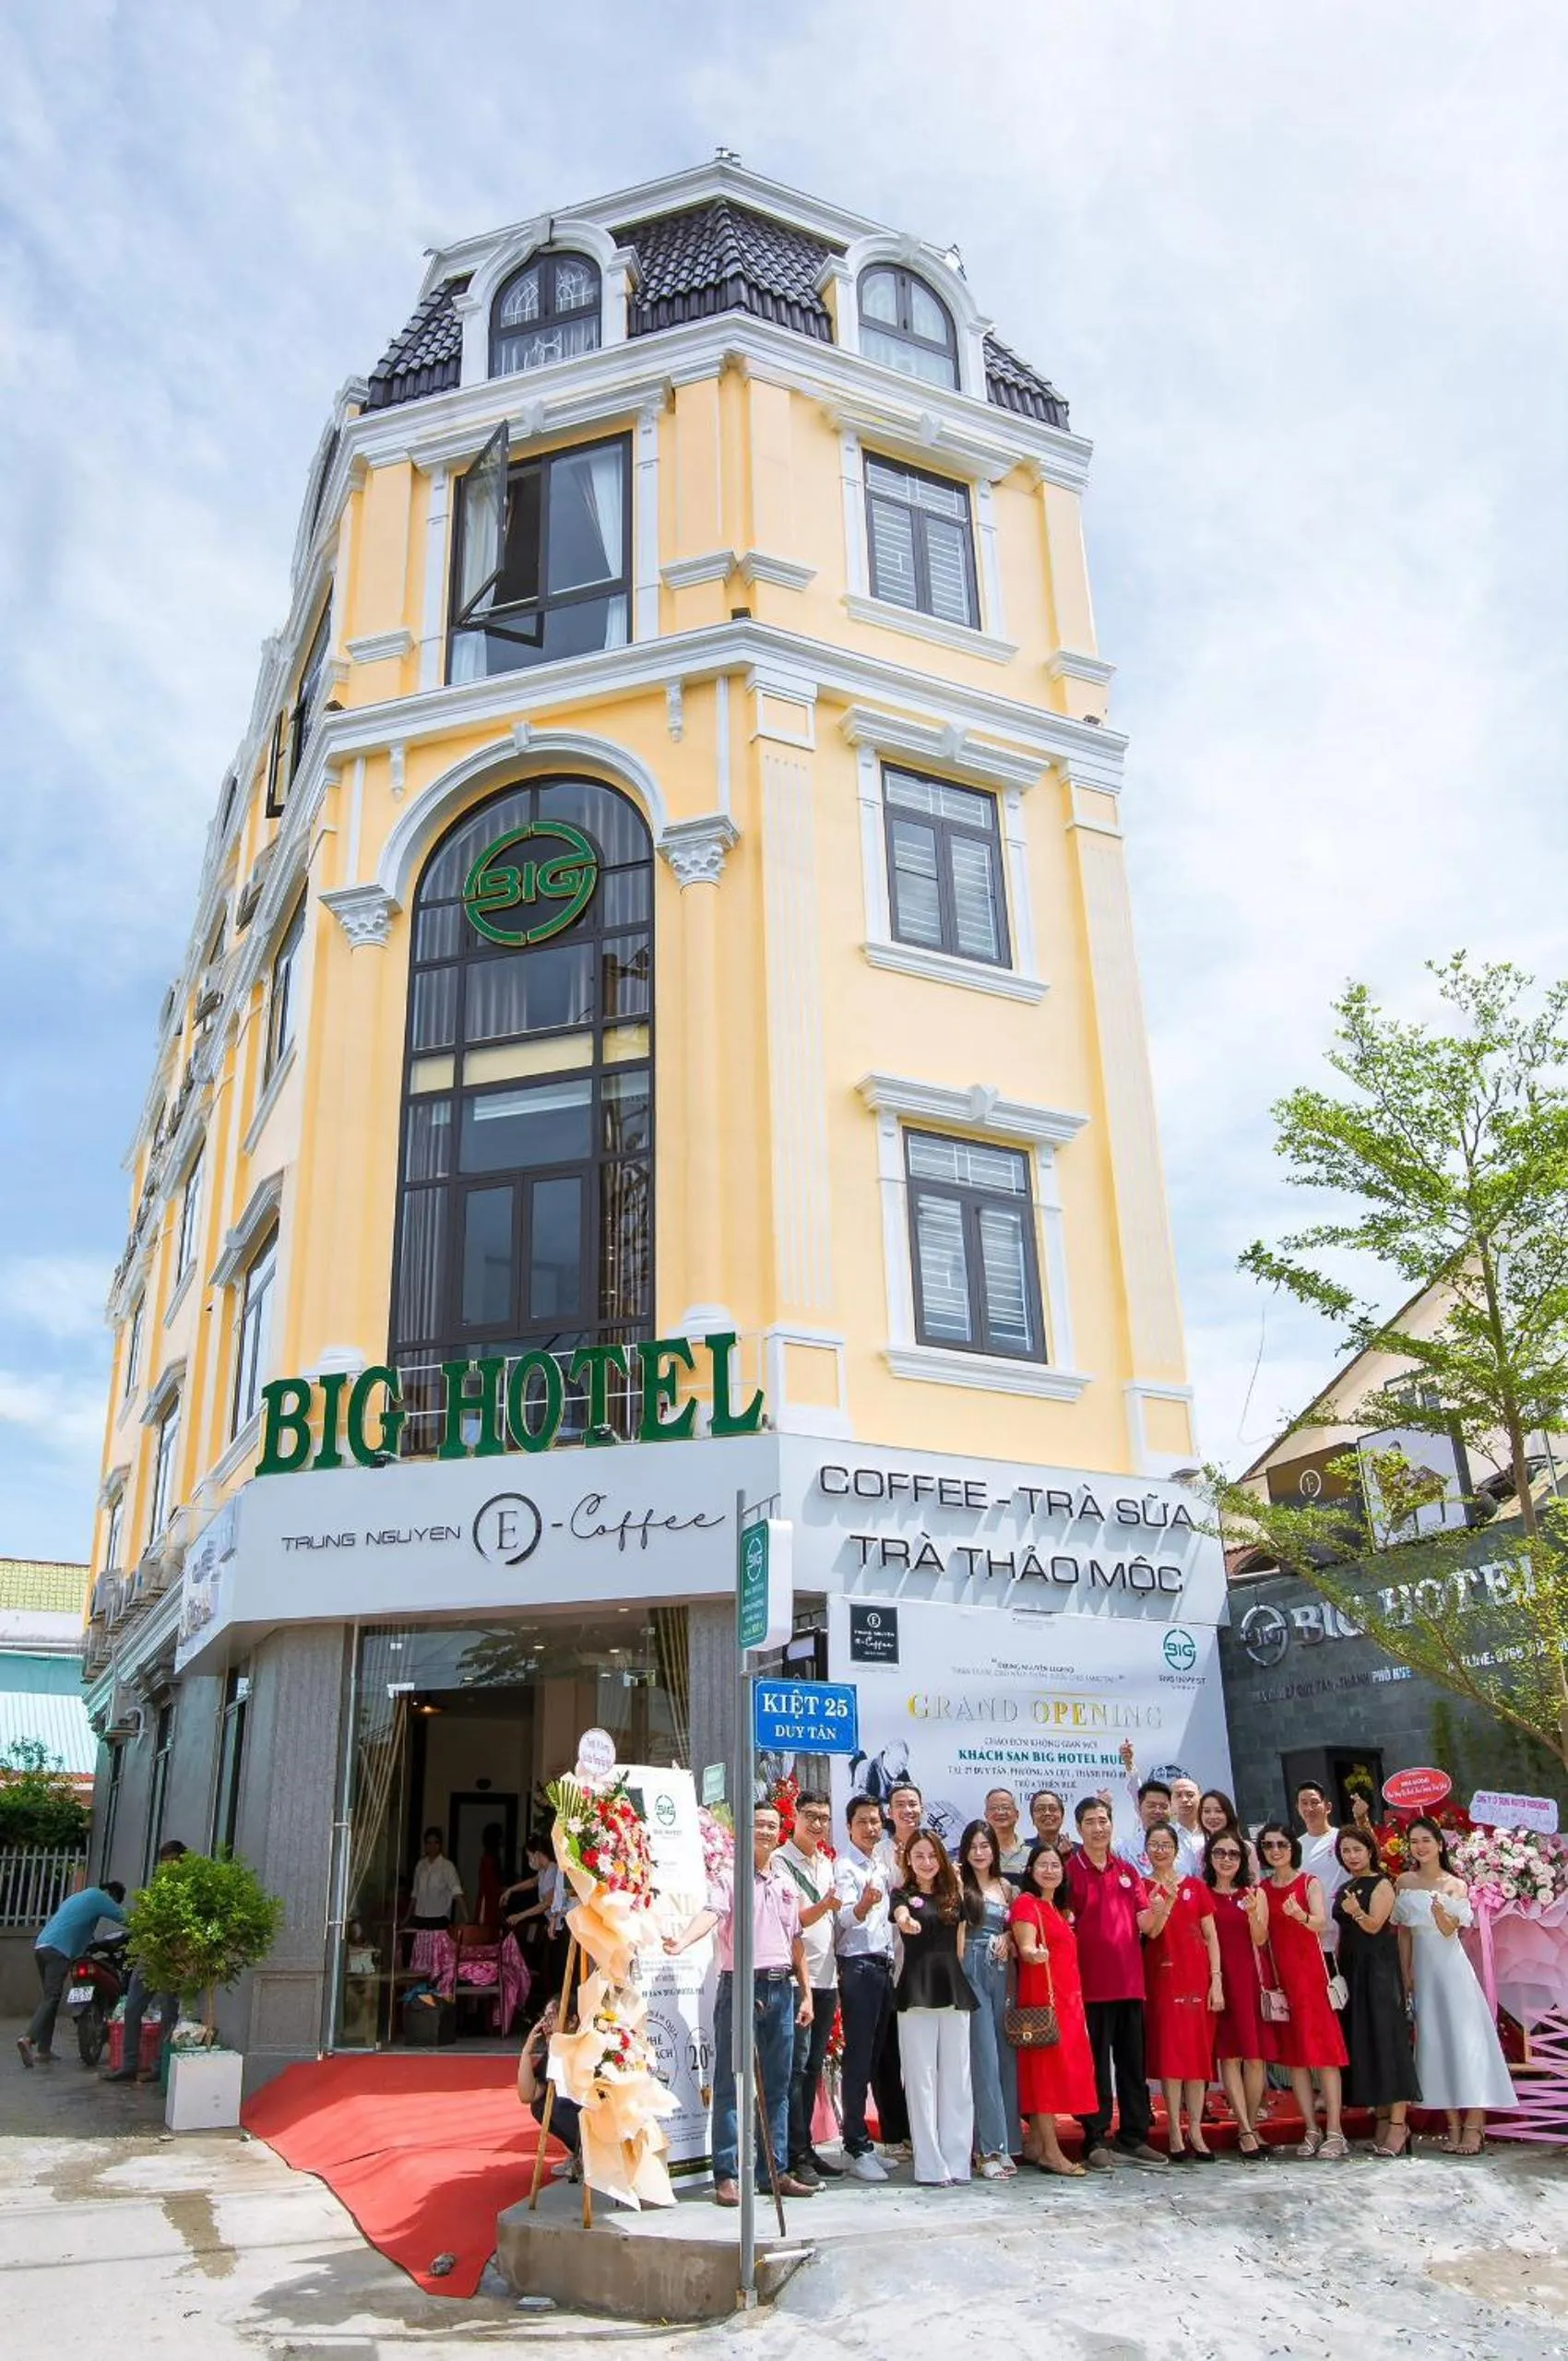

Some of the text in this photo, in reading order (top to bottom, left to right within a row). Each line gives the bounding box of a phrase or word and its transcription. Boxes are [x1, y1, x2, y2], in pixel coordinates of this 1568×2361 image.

[255, 1333, 764, 1476] BIG HOTEL
[820, 1465, 988, 1511] COFFEE
[1018, 1483, 1105, 1522] TRÀ
[1116, 1494, 1194, 1528] SỮA
[281, 1532, 356, 1552] TRUNG
[366, 1525, 461, 1546] NGUYEN
[849, 1532, 1183, 1597] TRÀ THẢO MỘC
[763, 1690, 849, 1719] KIỆT 25
[908, 1692, 1162, 1729] GRAND OPENING
[807, 1724, 837, 1741] TÂN
[1032, 1751, 1054, 1762] BIG
[1058, 1752, 1098, 1764] HOTEL
